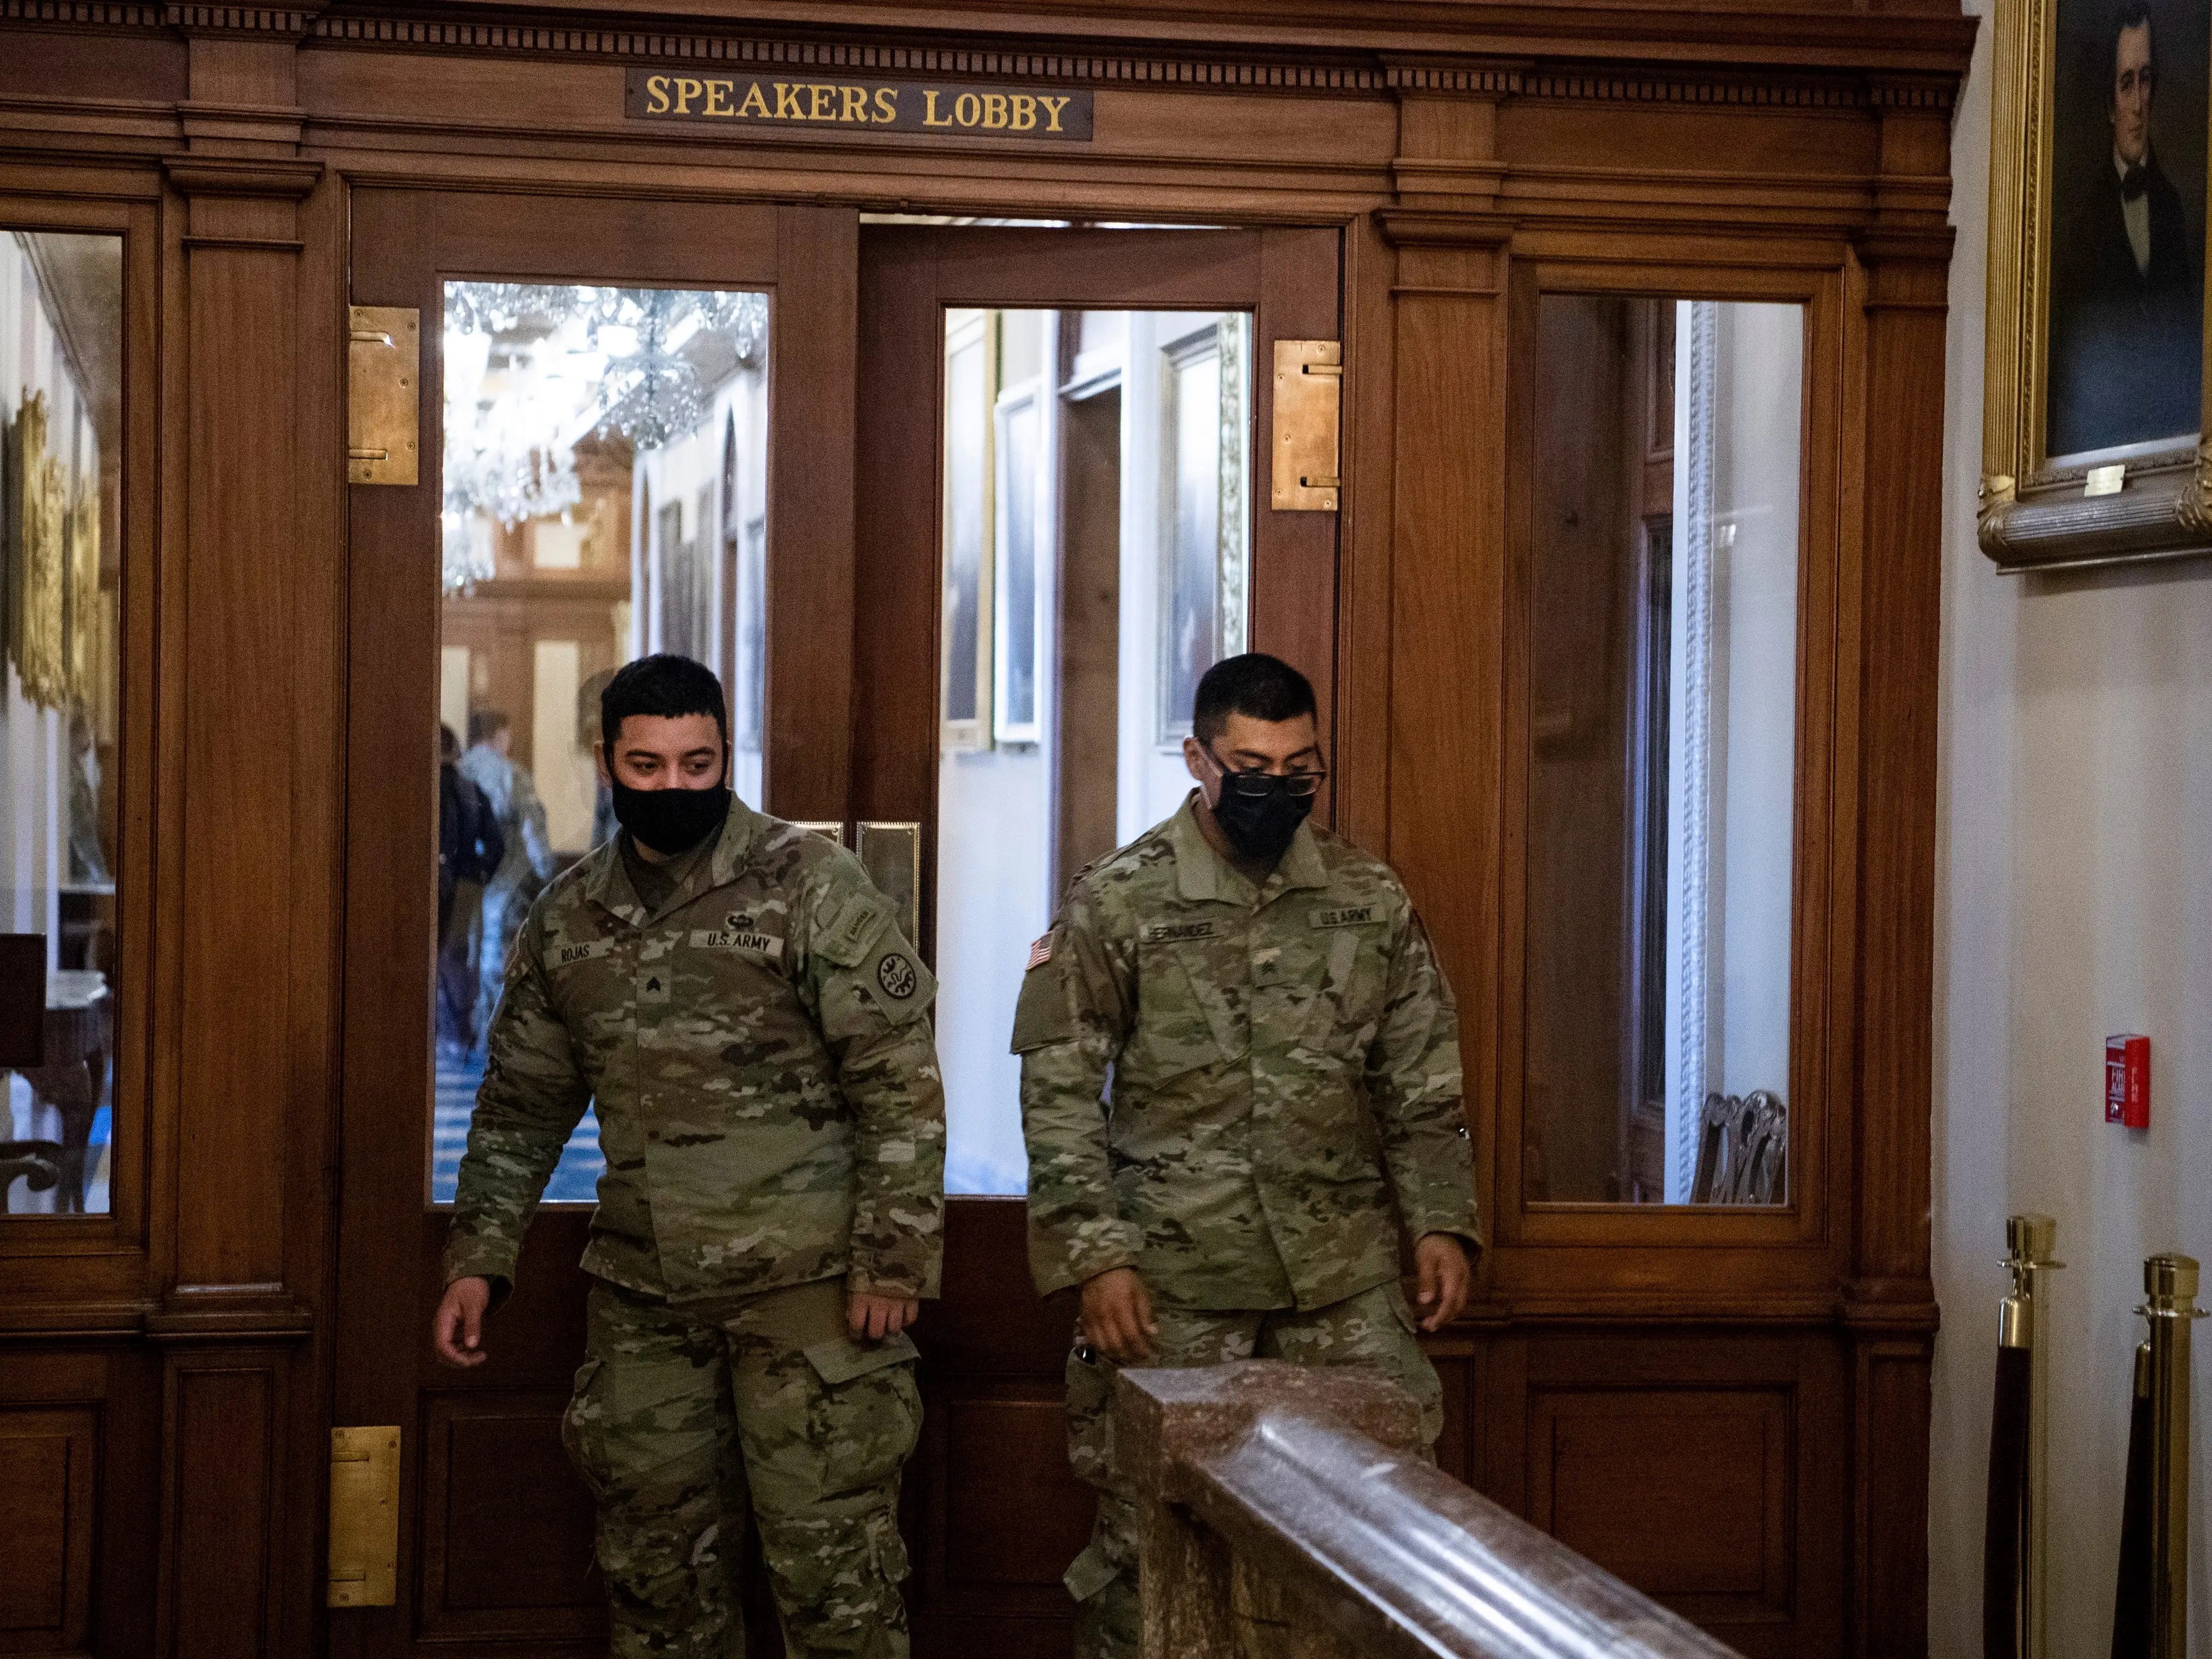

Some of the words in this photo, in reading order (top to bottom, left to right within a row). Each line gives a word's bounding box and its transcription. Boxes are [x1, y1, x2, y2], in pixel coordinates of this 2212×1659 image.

[646, 75, 899, 123] SPEAKERS
[922, 89, 1071, 132] LOBBY
[707, 933, 730, 947] U.S.
[732, 935, 771, 953] ARMY
[561, 944, 590, 964] ROJAS
